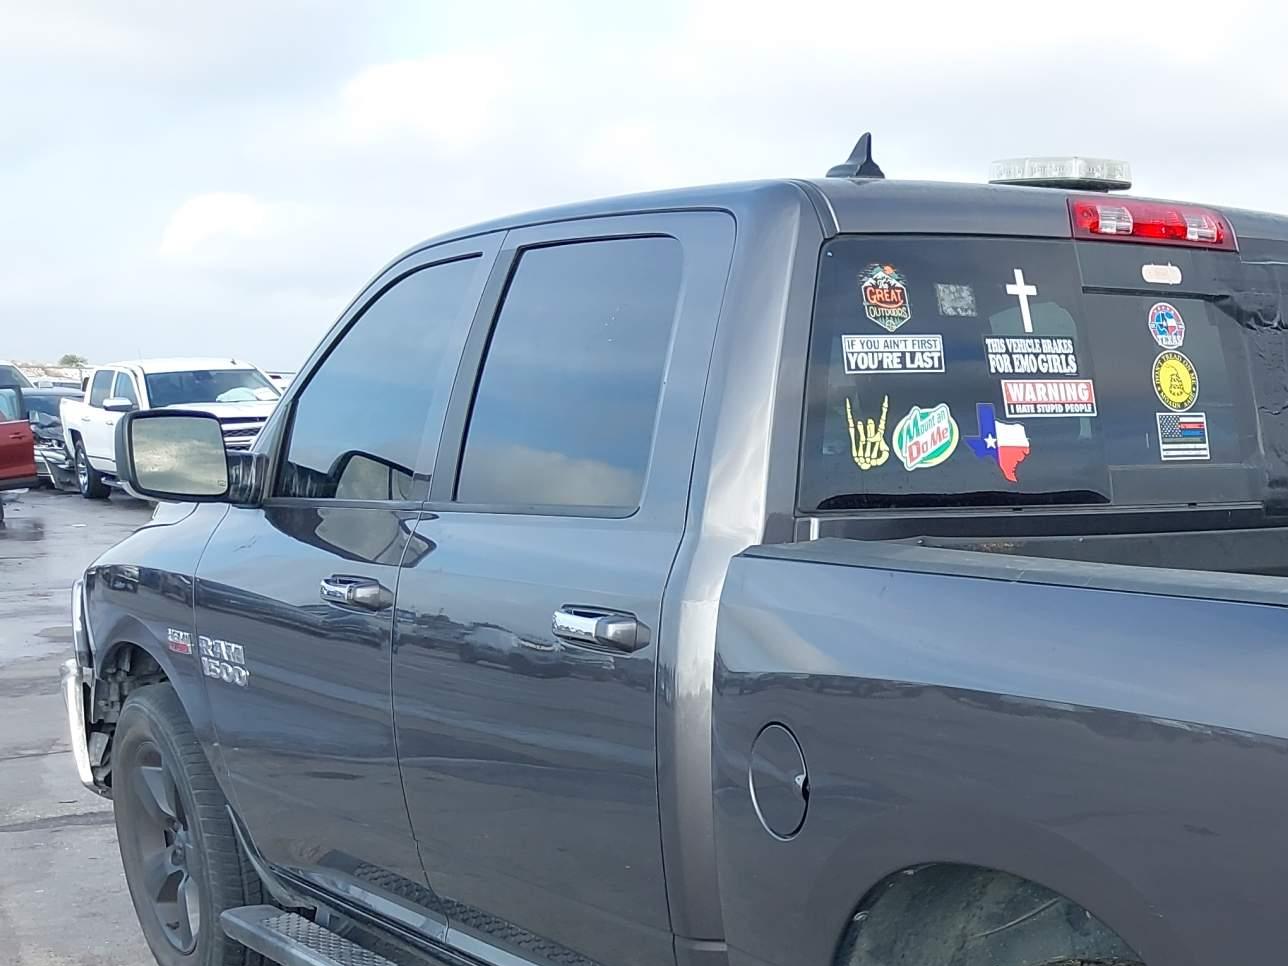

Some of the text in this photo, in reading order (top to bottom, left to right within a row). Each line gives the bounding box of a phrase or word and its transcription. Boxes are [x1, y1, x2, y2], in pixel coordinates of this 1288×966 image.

[866, 286, 904, 308] GREAT
[868, 306, 908, 318] OUTDOORS
[847, 339, 939, 350] IF YOU AIN'T FIRST
[985, 338, 1074, 354] THIS VEHICLE BRAKES
[847, 351, 940, 370] YOU'RE LAST
[988, 354, 1077, 373] FOR EMO GIRLS
[1007, 383, 1089, 402] WARNING
[1010, 404, 1092, 414] I HATE STUPID PEOPLE
[931, 426, 949, 449] Me
[198, 635, 245, 665] RAM
[201, 656, 248, 687] 1500
